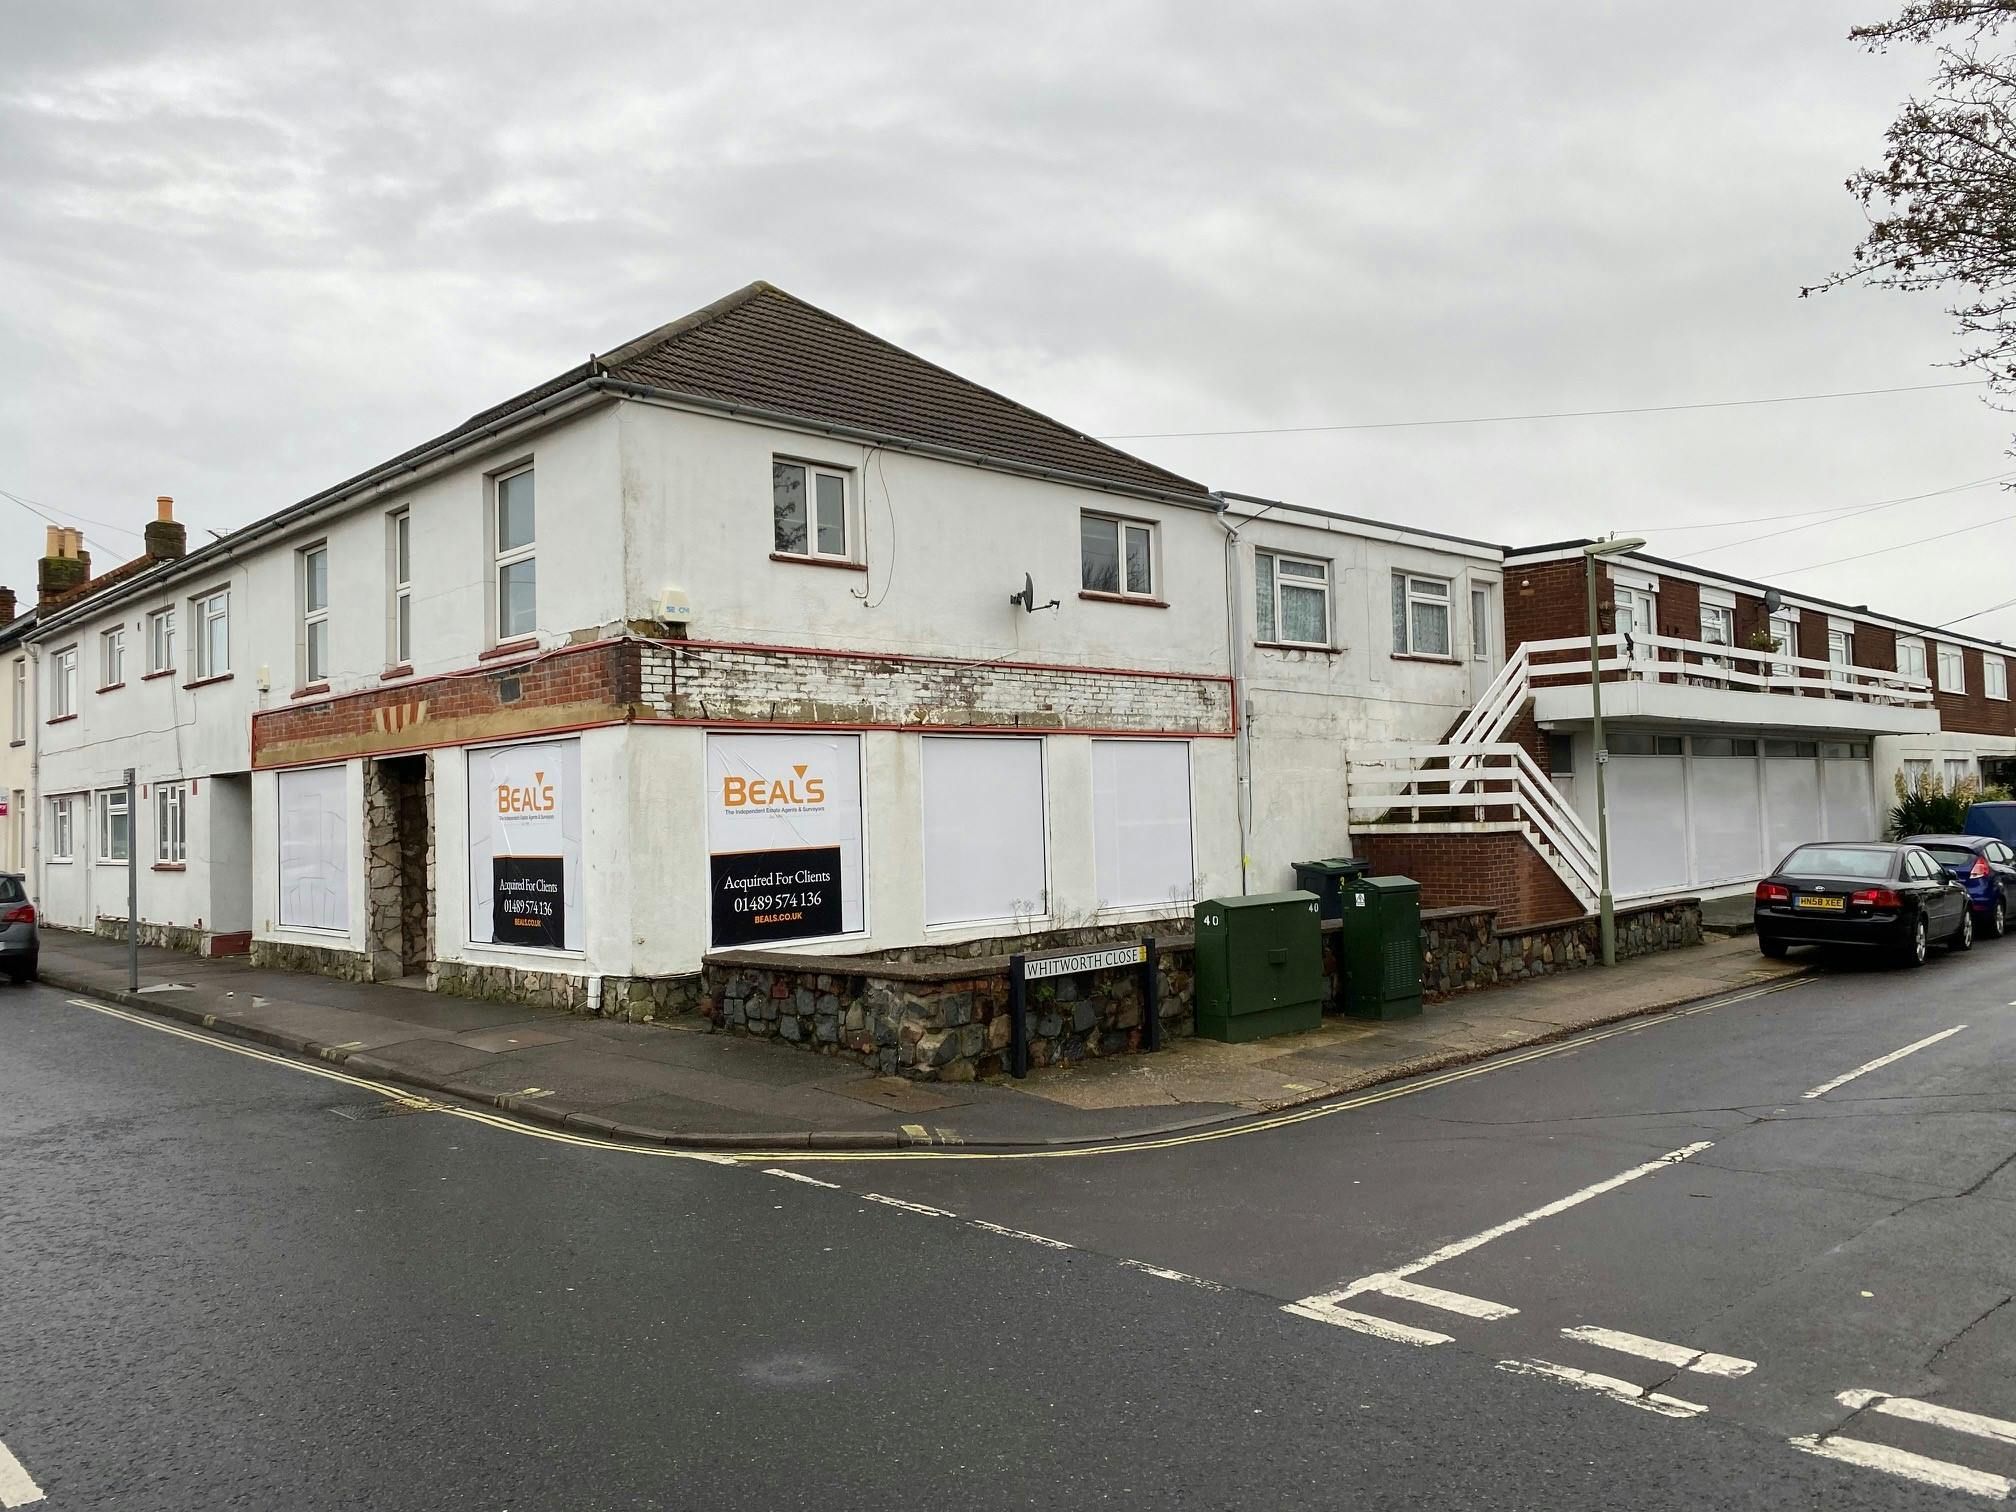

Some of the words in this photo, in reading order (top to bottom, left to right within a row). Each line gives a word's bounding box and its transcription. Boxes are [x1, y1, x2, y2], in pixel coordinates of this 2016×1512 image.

[499, 878, 525, 895] Acquired
[525, 879, 536, 892] For
[536, 878, 558, 893] Clients
[723, 872, 774, 893] Acquired
[775, 872, 794, 886] For
[794, 869, 831, 884] Clients
[503, 899, 525, 914] 01489
[525, 900, 539, 915] 574
[539, 901, 553, 916] 136
[734, 895, 773, 912] 01489
[775, 893, 798, 909] 574
[800, 891, 822, 907] 136
[1308, 903, 1319, 913] 40
[1825, 898, 1842, 907] XEE
[754, 912, 803, 923] BEALS.CO.UK
[1203, 914, 1219, 926] 40
[1026, 955, 1102, 977] WHITWORTH
[1105, 949, 1138, 966] CLOSE
